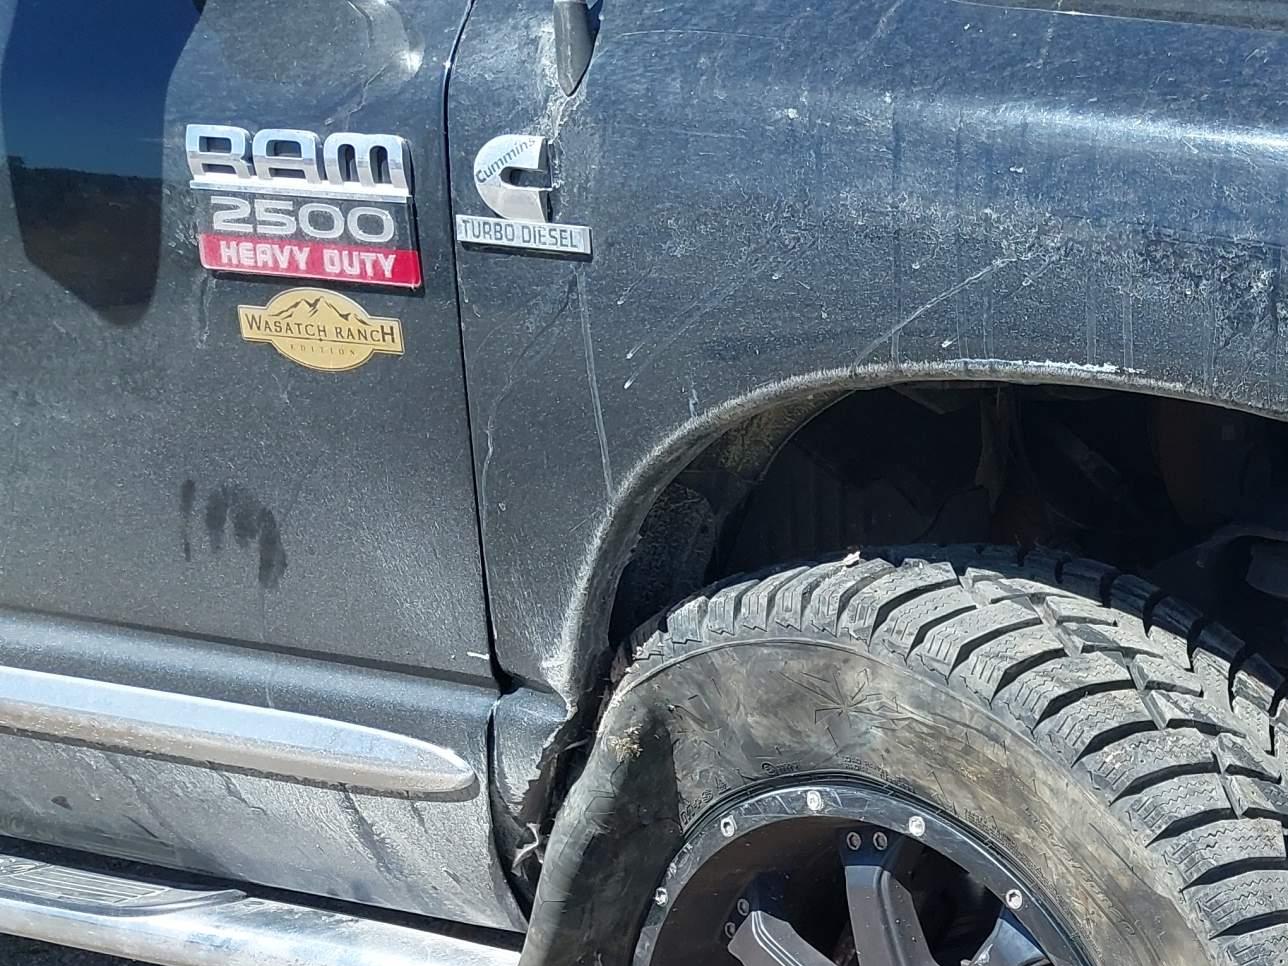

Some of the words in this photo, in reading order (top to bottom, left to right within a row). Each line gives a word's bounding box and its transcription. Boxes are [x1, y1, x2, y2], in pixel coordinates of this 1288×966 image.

[186, 124, 411, 190] RAM
[474, 136, 537, 183] Cummins
[210, 196, 395, 243] 2500
[461, 218, 515, 242] TURBO
[520, 221, 580, 250] DIESEL
[220, 240, 309, 271] HEAVY
[323, 248, 397, 279] DUTY
